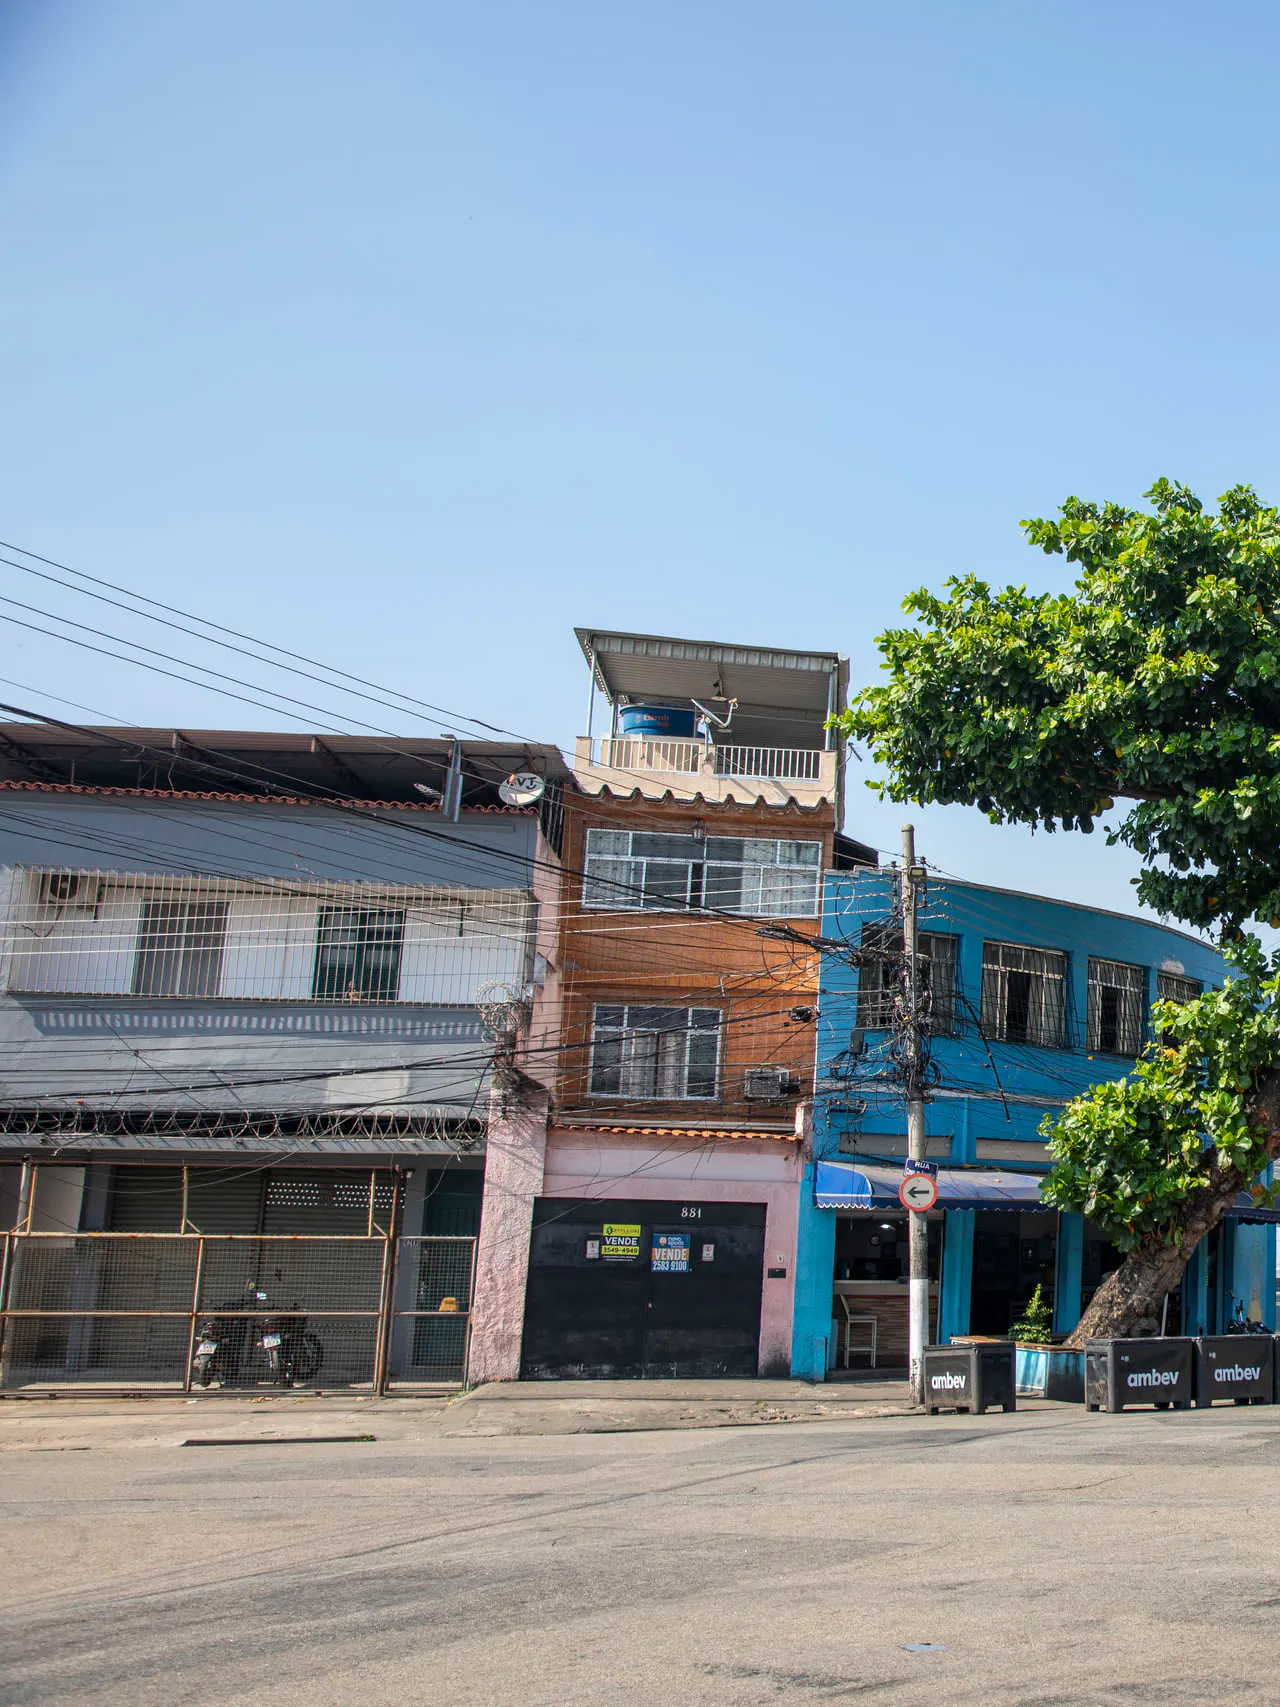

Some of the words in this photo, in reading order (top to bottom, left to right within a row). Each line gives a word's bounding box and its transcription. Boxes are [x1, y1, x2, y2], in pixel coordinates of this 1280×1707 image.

[914, 1161, 930, 1170] RUA
[681, 1206, 702, 1218] 881
[605, 1237, 638, 1246] VENDE
[654, 1248, 688, 1261] VENDE
[652, 1260, 670, 1271] 2583
[670, 1260, 688, 1271] 9100
[1127, 1368, 1179, 1387] ambev
[1214, 1364, 1261, 1382] ambev
[931, 1371, 966, 1389] ambev
